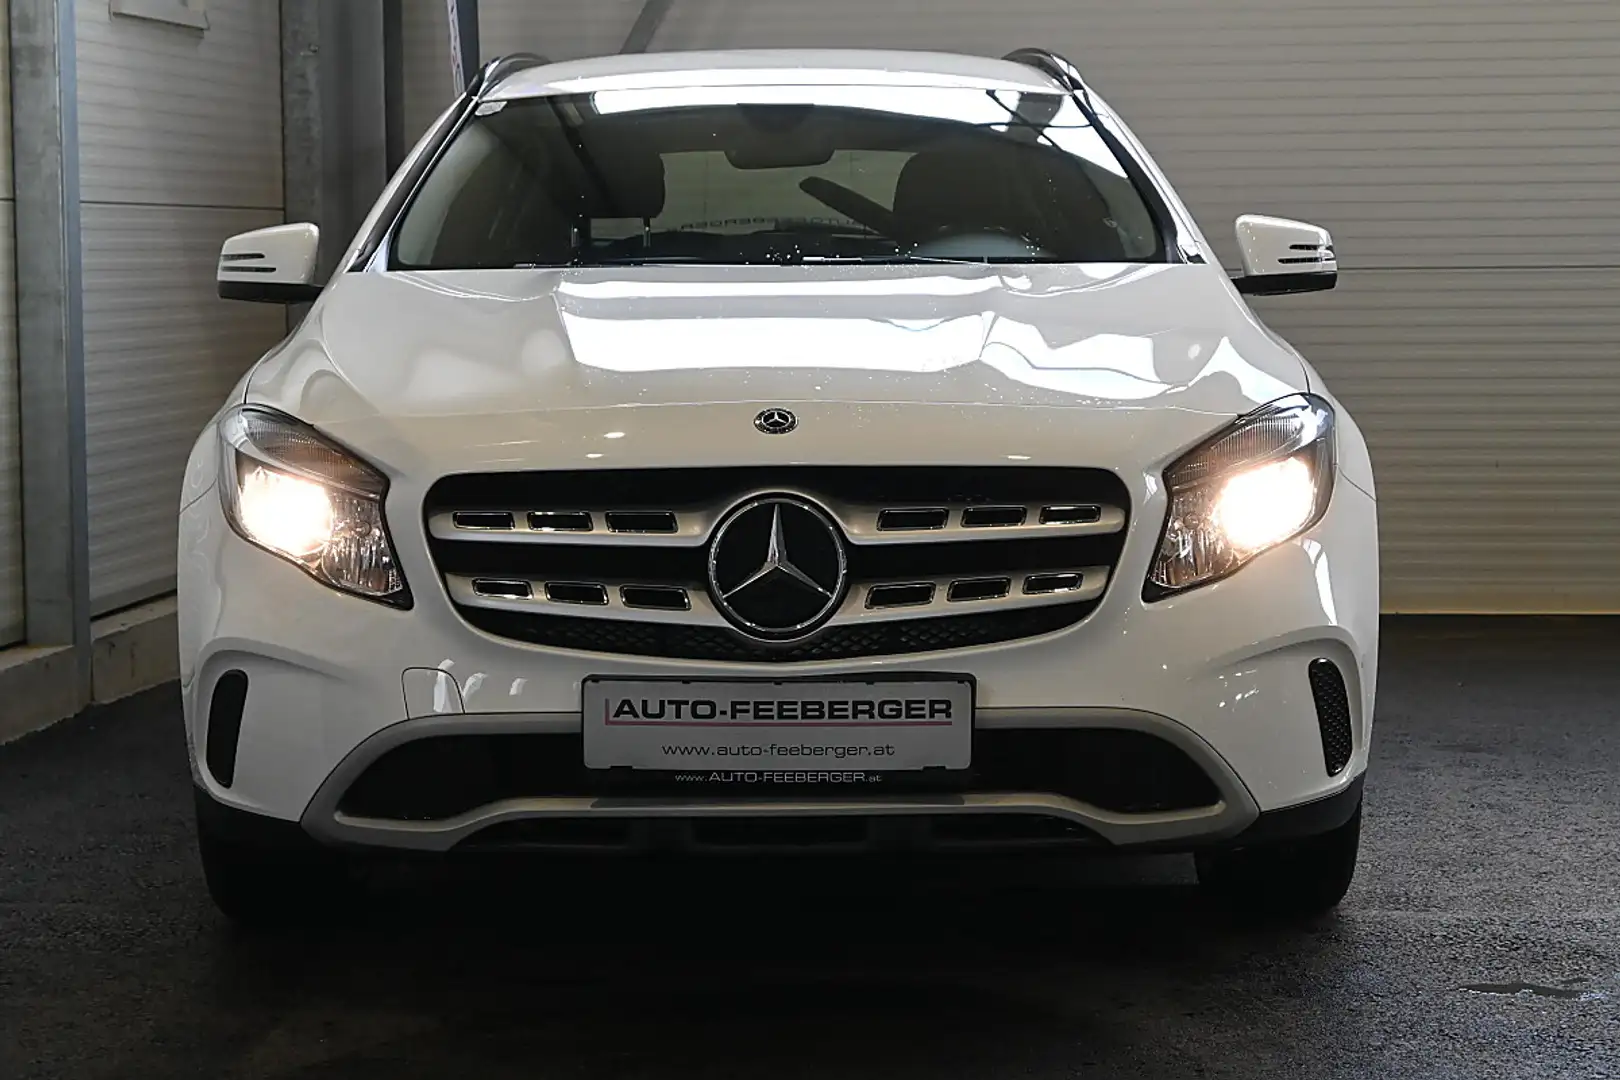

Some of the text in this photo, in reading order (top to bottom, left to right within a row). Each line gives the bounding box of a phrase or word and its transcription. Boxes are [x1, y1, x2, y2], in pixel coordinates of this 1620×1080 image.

[613, 699, 952, 720] AUTO-FEEBERGER
[662, 744, 895, 758] www.auto-feeberger.at
[675, 772, 882, 783] www.AUTO-FEEBERGER.at
